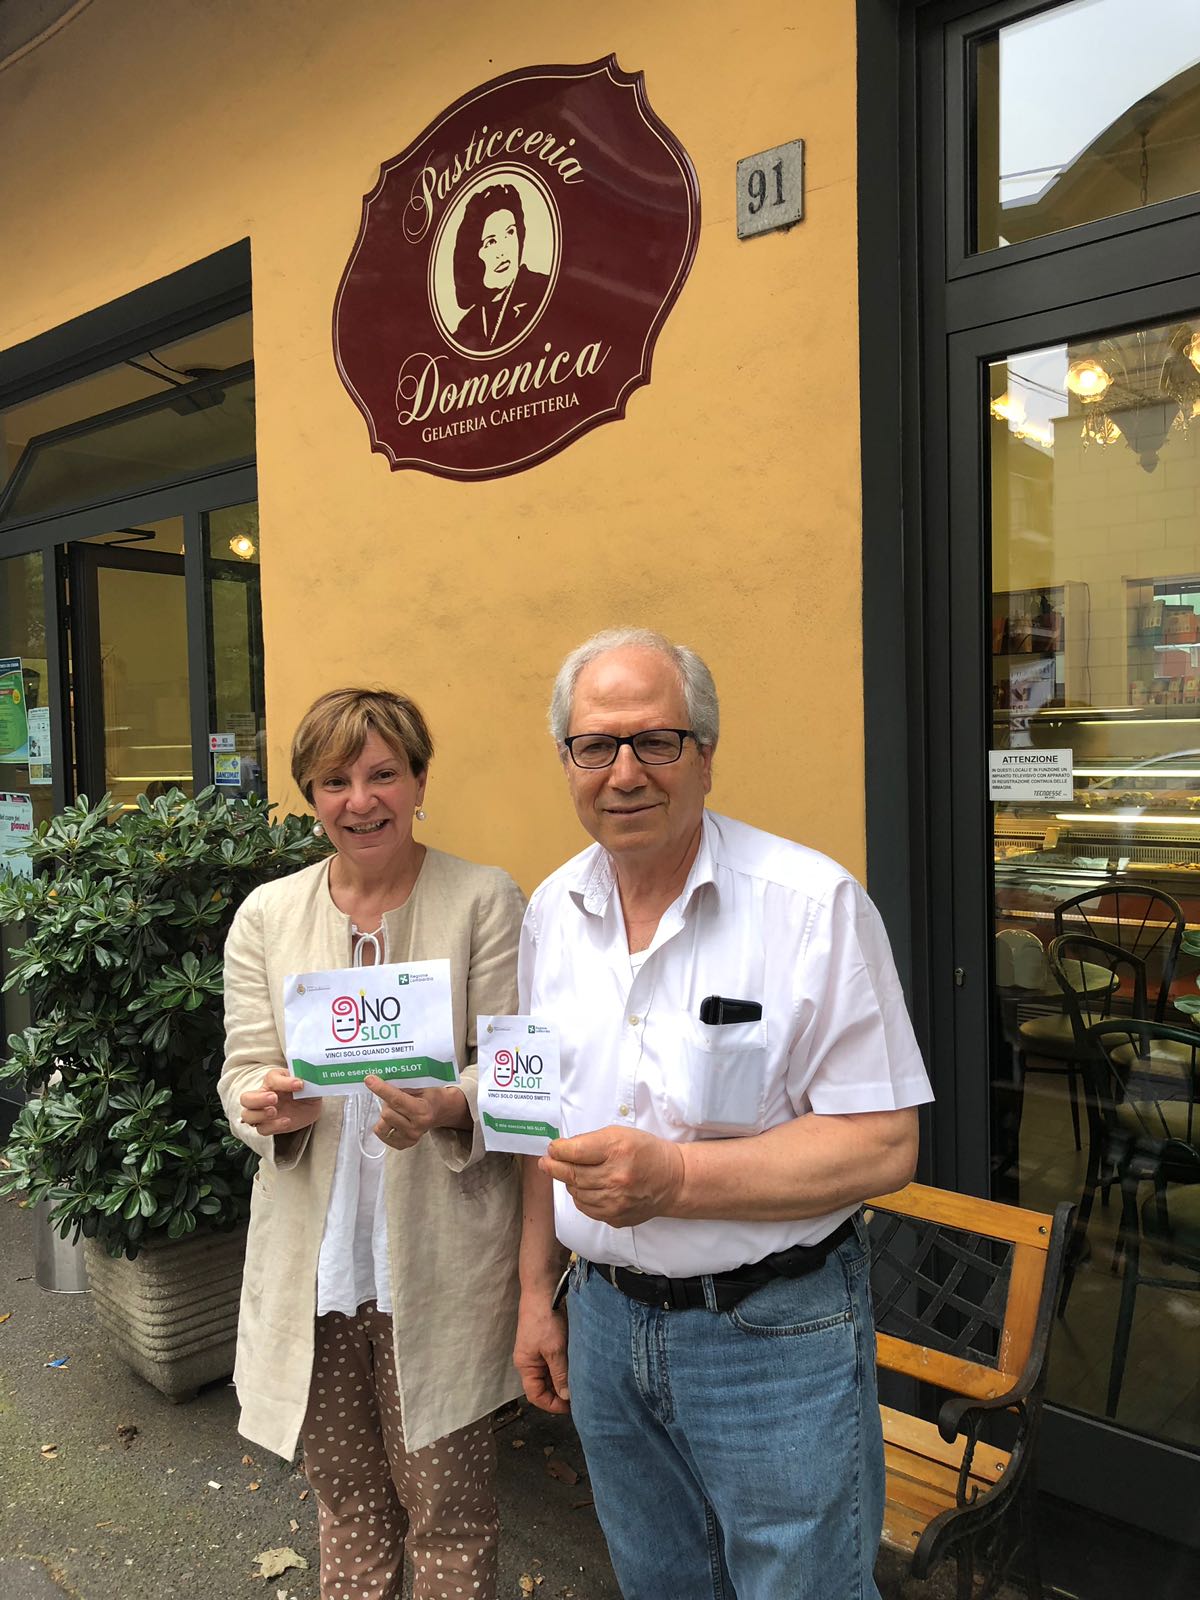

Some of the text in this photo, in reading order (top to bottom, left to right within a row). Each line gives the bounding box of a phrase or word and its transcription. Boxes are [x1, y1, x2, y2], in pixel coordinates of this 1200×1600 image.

[403, 125, 585, 244] Pasticceria
[747, 159, 787, 215] 91
[395, 338, 612, 426] Domenica
[421, 392, 580, 443] GELATERIA CAFFETTERIA
[1002, 755, 1059, 764] ATTENZIONE
[361, 996, 401, 1023] NO
[361, 1023, 401, 1041] SLOT
[361, 1047, 390, 1056] QUANDO
[391, 1045, 414, 1054] SMETTI
[330, 1069, 345, 1077] mio
[347, 1067, 383, 1077] esercizio
[385, 1063, 422, 1074] NO-SLOT
[514, 1051, 544, 1075] NO
[513, 1076, 543, 1089] SLOT
